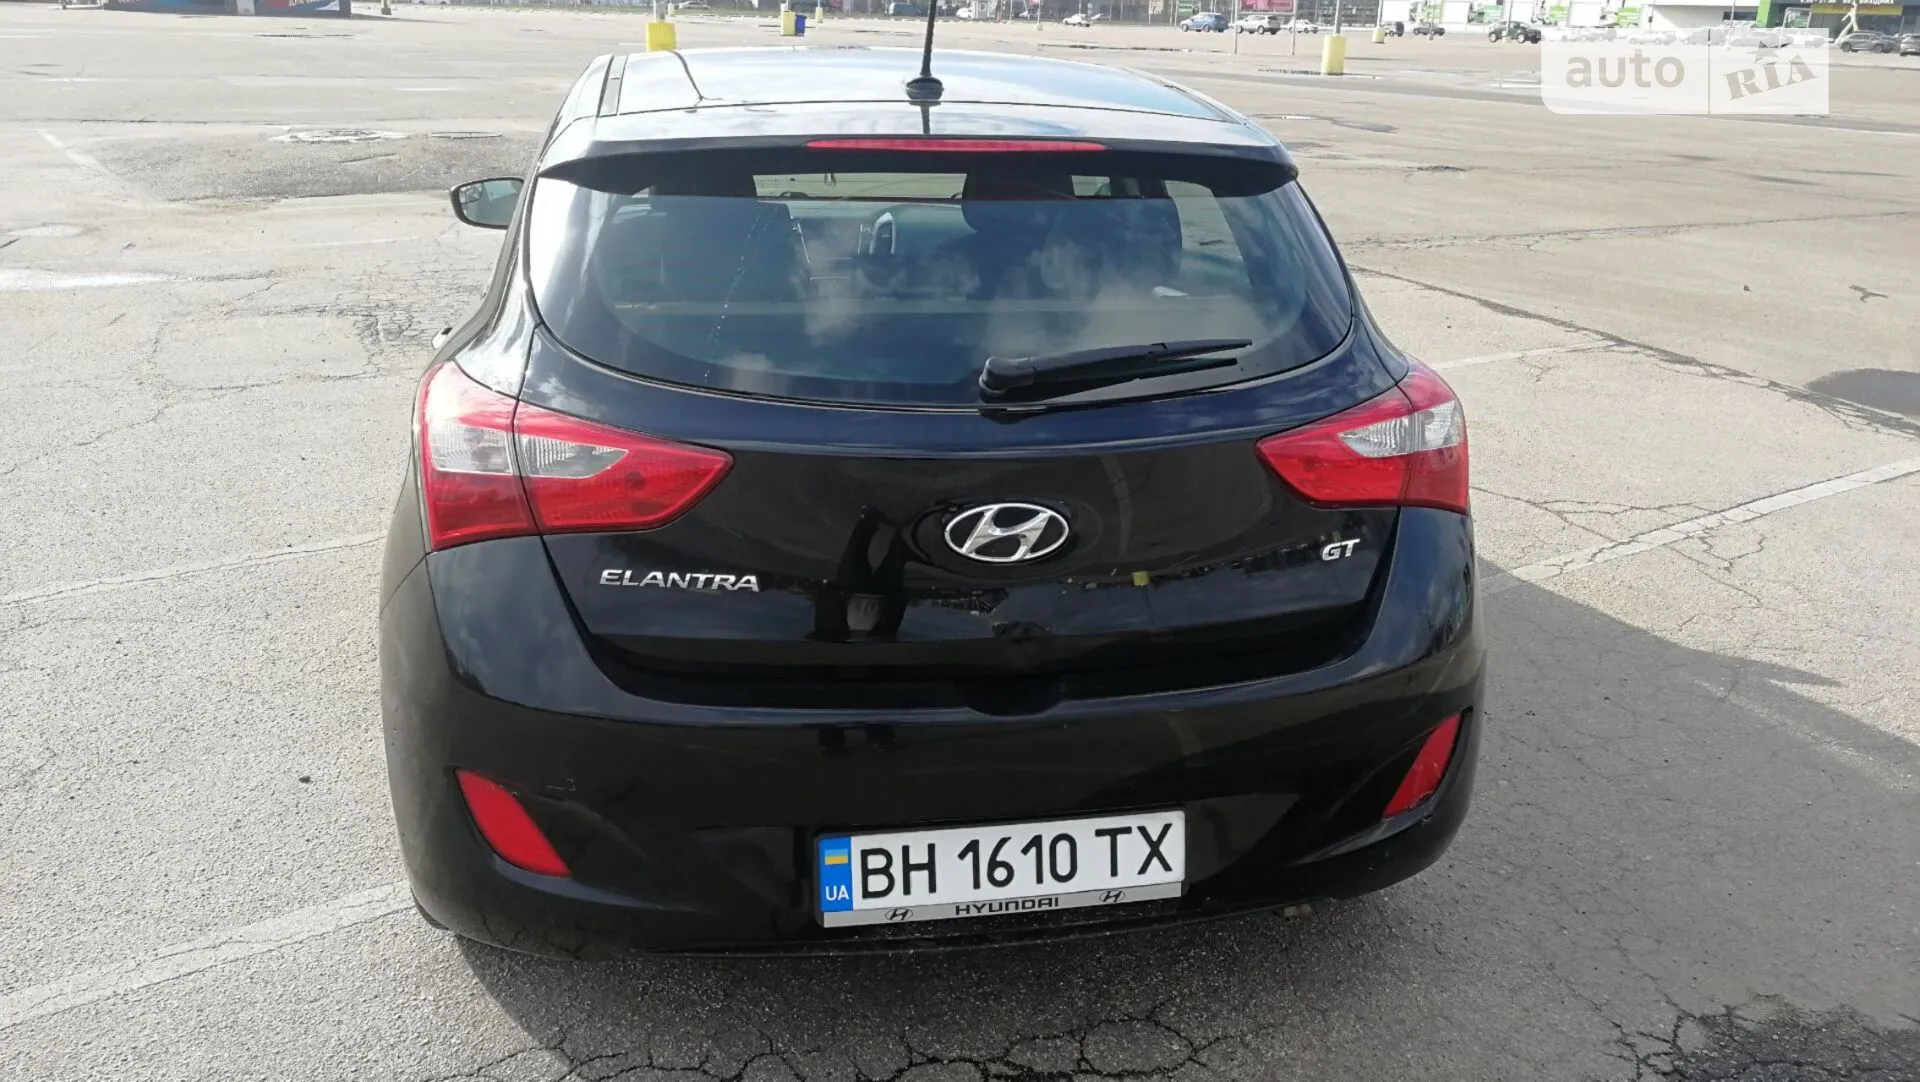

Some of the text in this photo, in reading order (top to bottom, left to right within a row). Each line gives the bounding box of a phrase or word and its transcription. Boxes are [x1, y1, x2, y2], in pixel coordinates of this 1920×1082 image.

[1322, 538, 1361, 561] GT
[599, 569, 760, 593] ELANTRA
[860, 822, 1174, 900] BH 1610 TX
[825, 884, 850, 901] UA
[954, 896, 1059, 916] HYUNDAI
